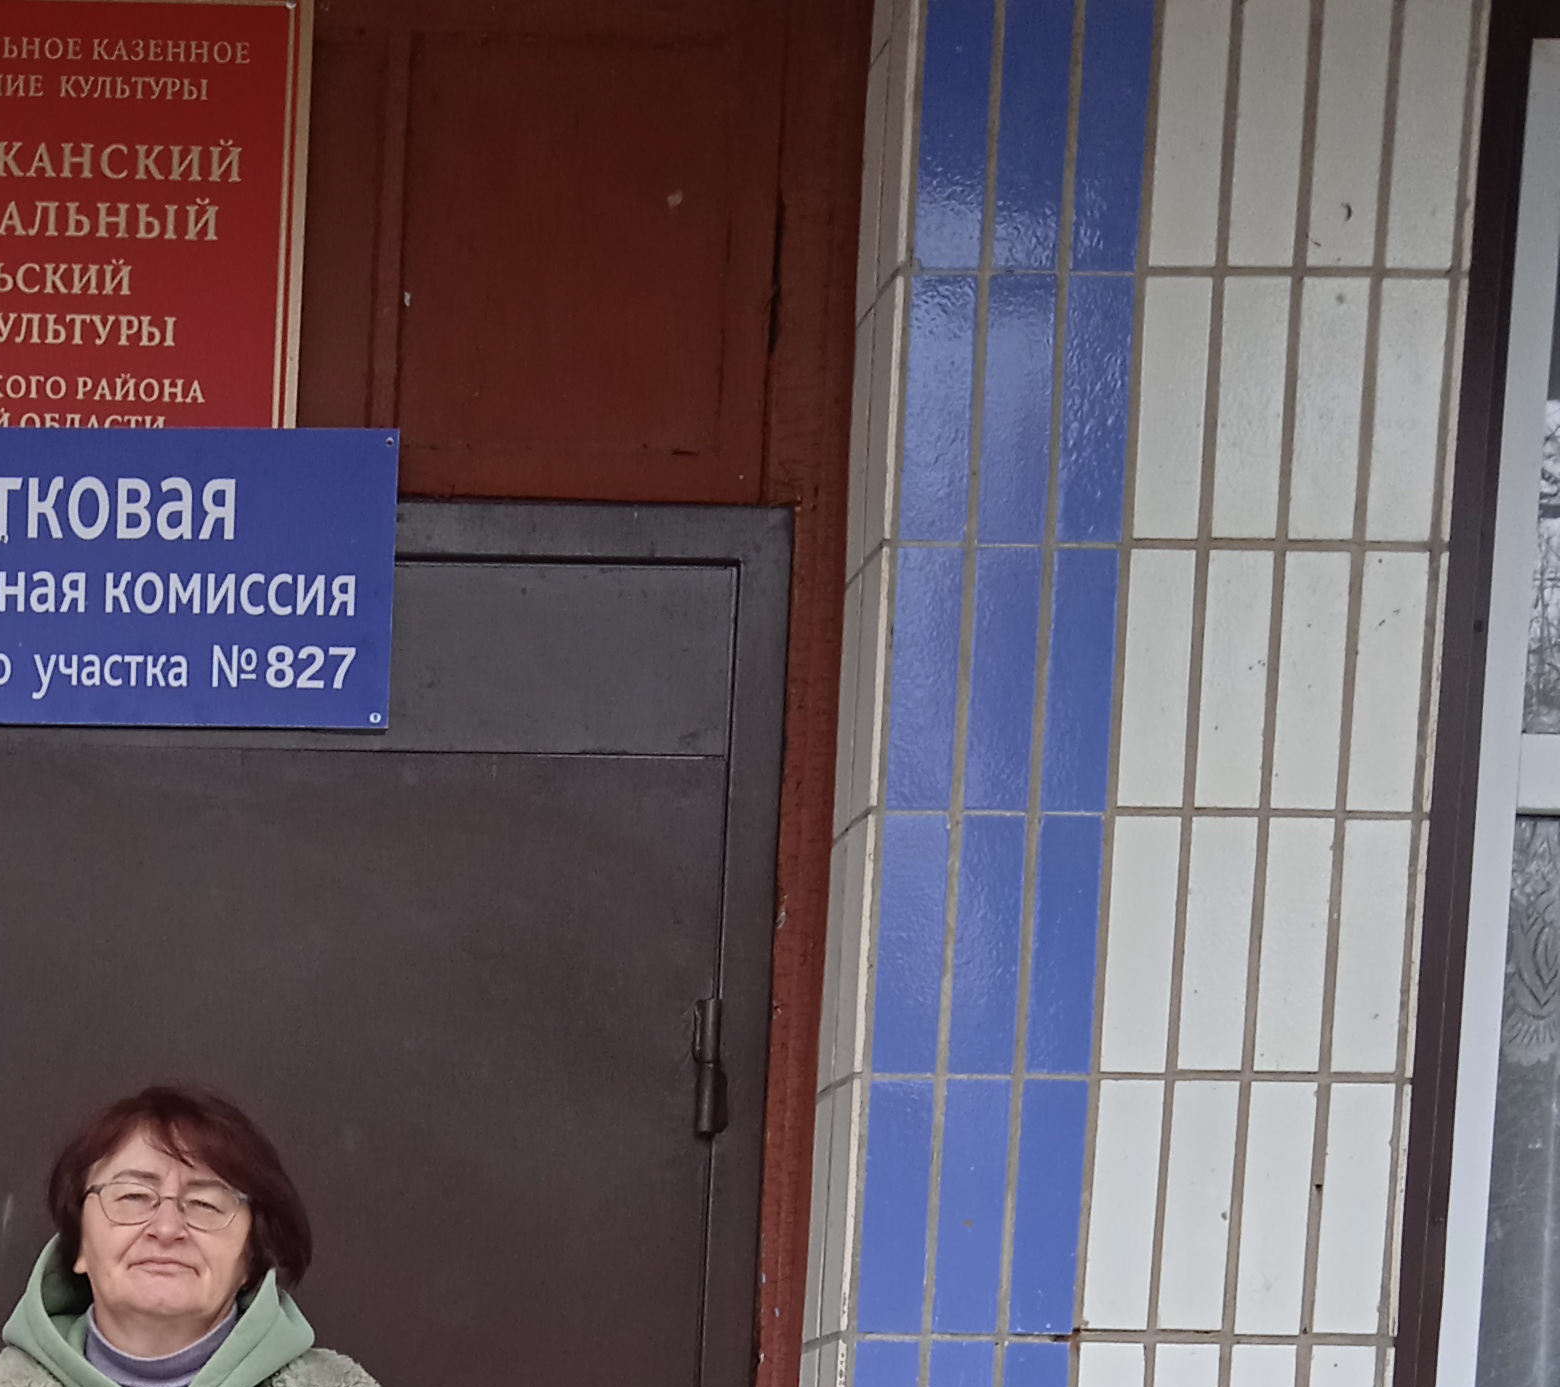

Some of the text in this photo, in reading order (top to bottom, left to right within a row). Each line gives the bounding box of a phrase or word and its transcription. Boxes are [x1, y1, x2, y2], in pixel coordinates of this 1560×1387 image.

[93, 39, 251, 64] КАЗЕННОЕ
[59, 76, 209, 101] КУЛЬТУРЫ
[76, 376, 205, 404] РАЙОНА
[104, 571, 356, 617] комиссия
[33, 650, 189, 700] участка
